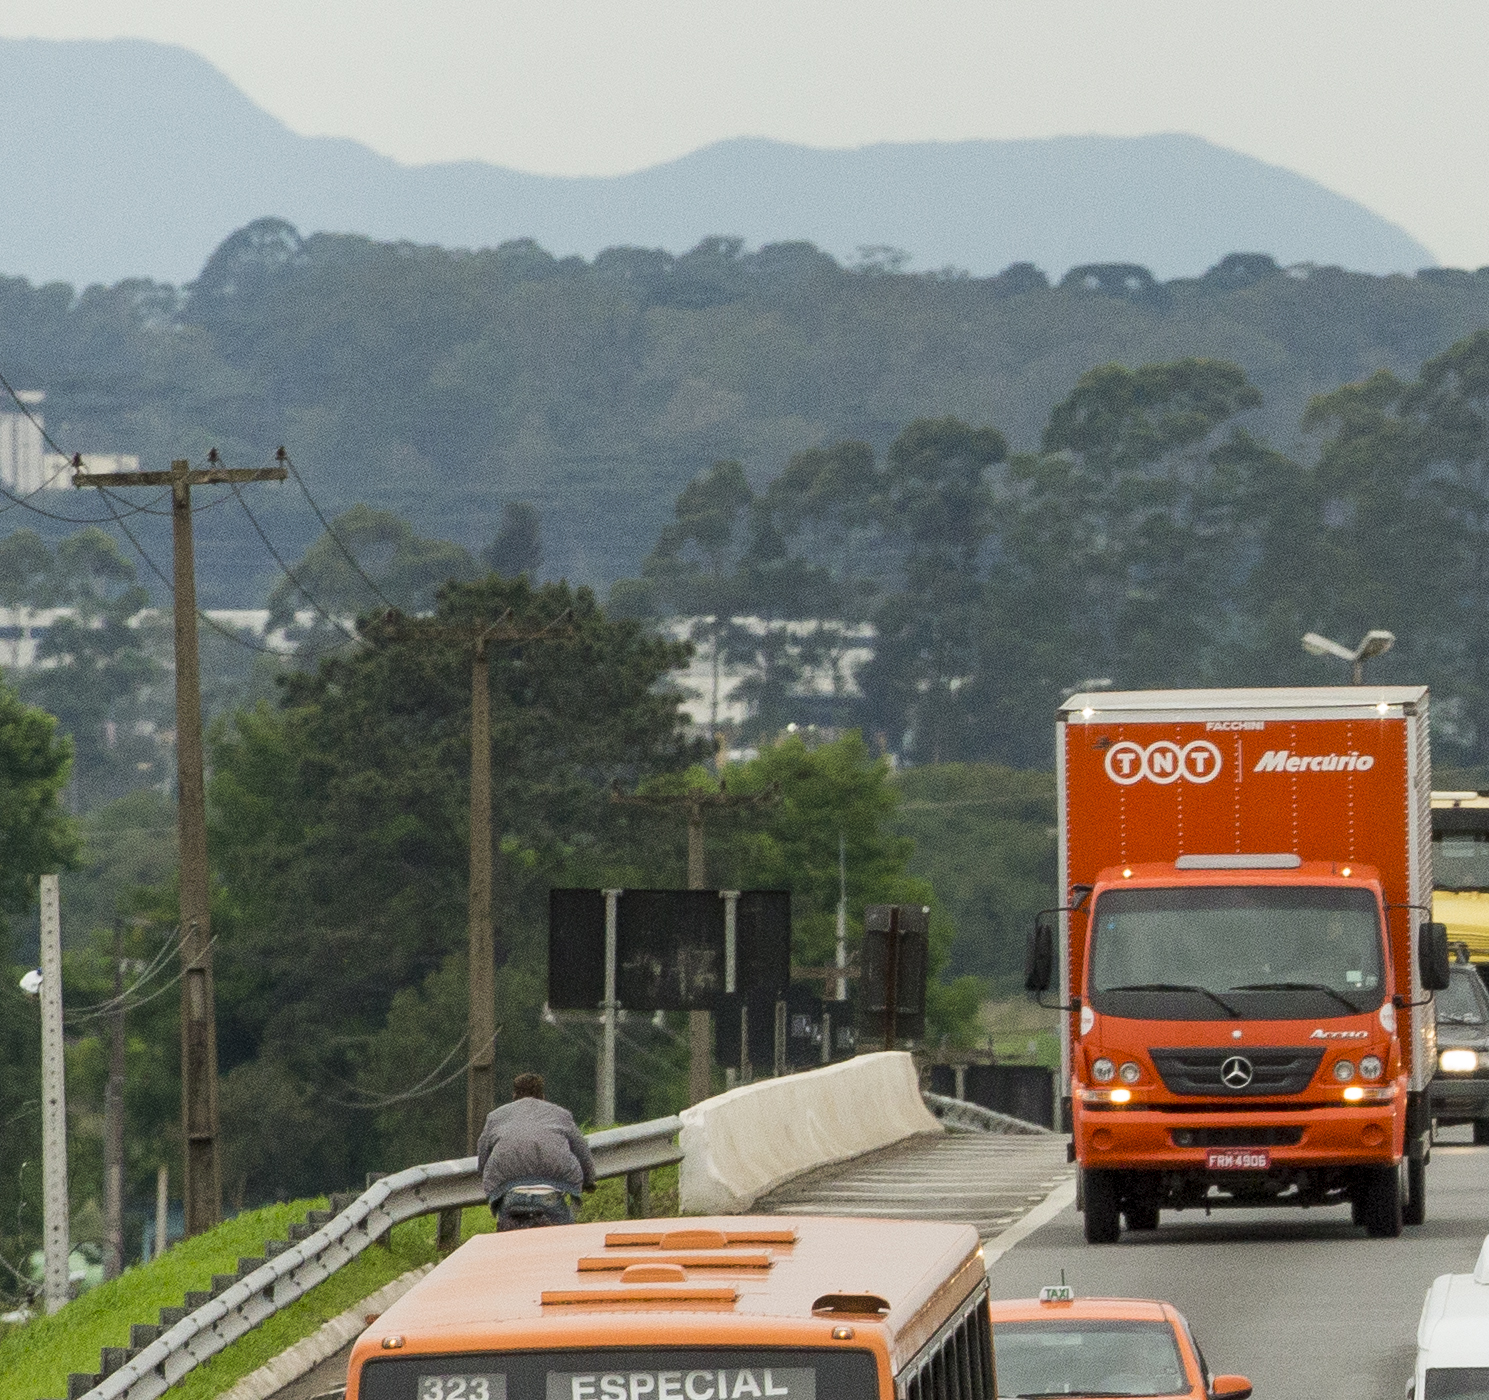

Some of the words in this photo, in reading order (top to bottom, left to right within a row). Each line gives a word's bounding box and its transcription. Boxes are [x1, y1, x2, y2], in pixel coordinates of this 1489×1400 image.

[1205, 720, 1265, 731] FACCHINI
[1107, 746, 1220, 780] TNT
[1253, 751, 1374, 772] Mercúrio
[1045, 1289, 1070, 1300] TAXI
